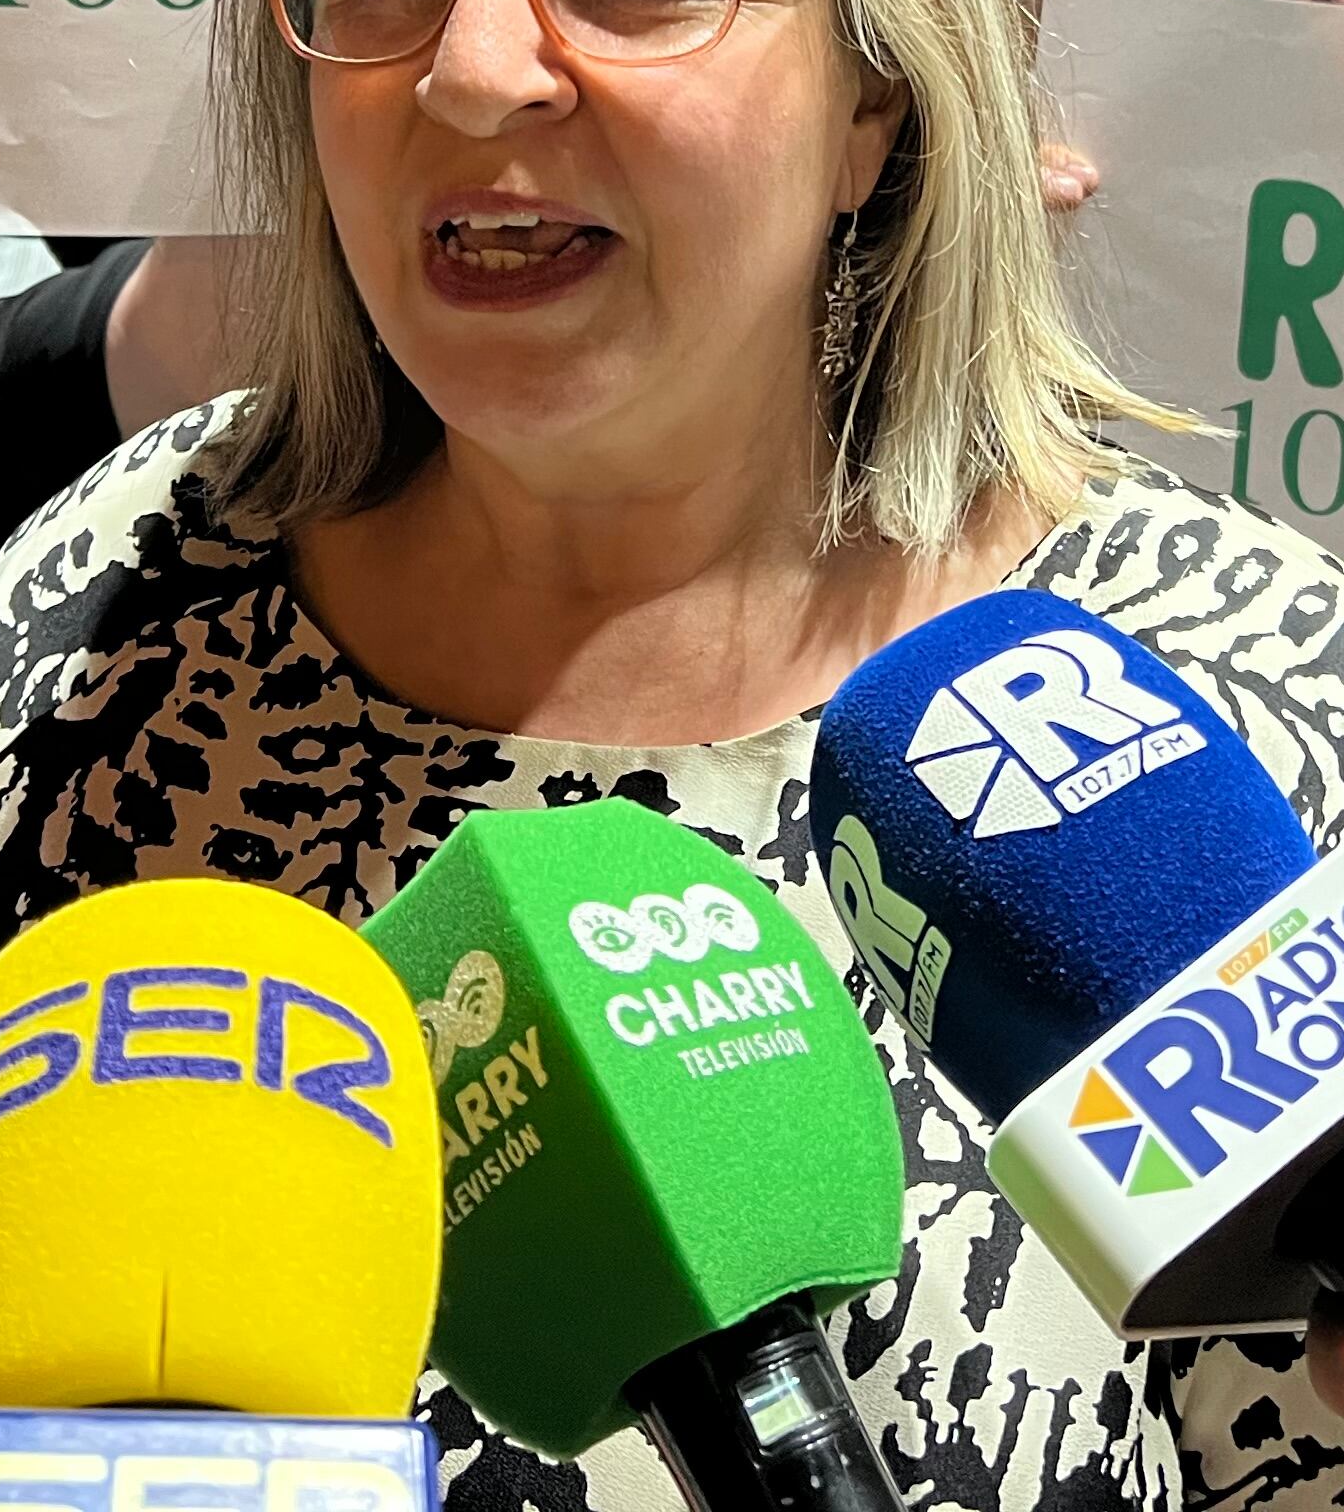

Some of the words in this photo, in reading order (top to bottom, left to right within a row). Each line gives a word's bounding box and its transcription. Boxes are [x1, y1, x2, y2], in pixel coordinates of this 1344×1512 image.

[1066, 753, 1133, 804] 107.7
[1149, 732, 1182, 759] FM
[1271, 915, 1301, 943] FM
[604, 960, 815, 1047] CHARRY
[676, 1020, 810, 1079] TELEVISIÓN
[440, 1025, 549, 1174] ARRY
